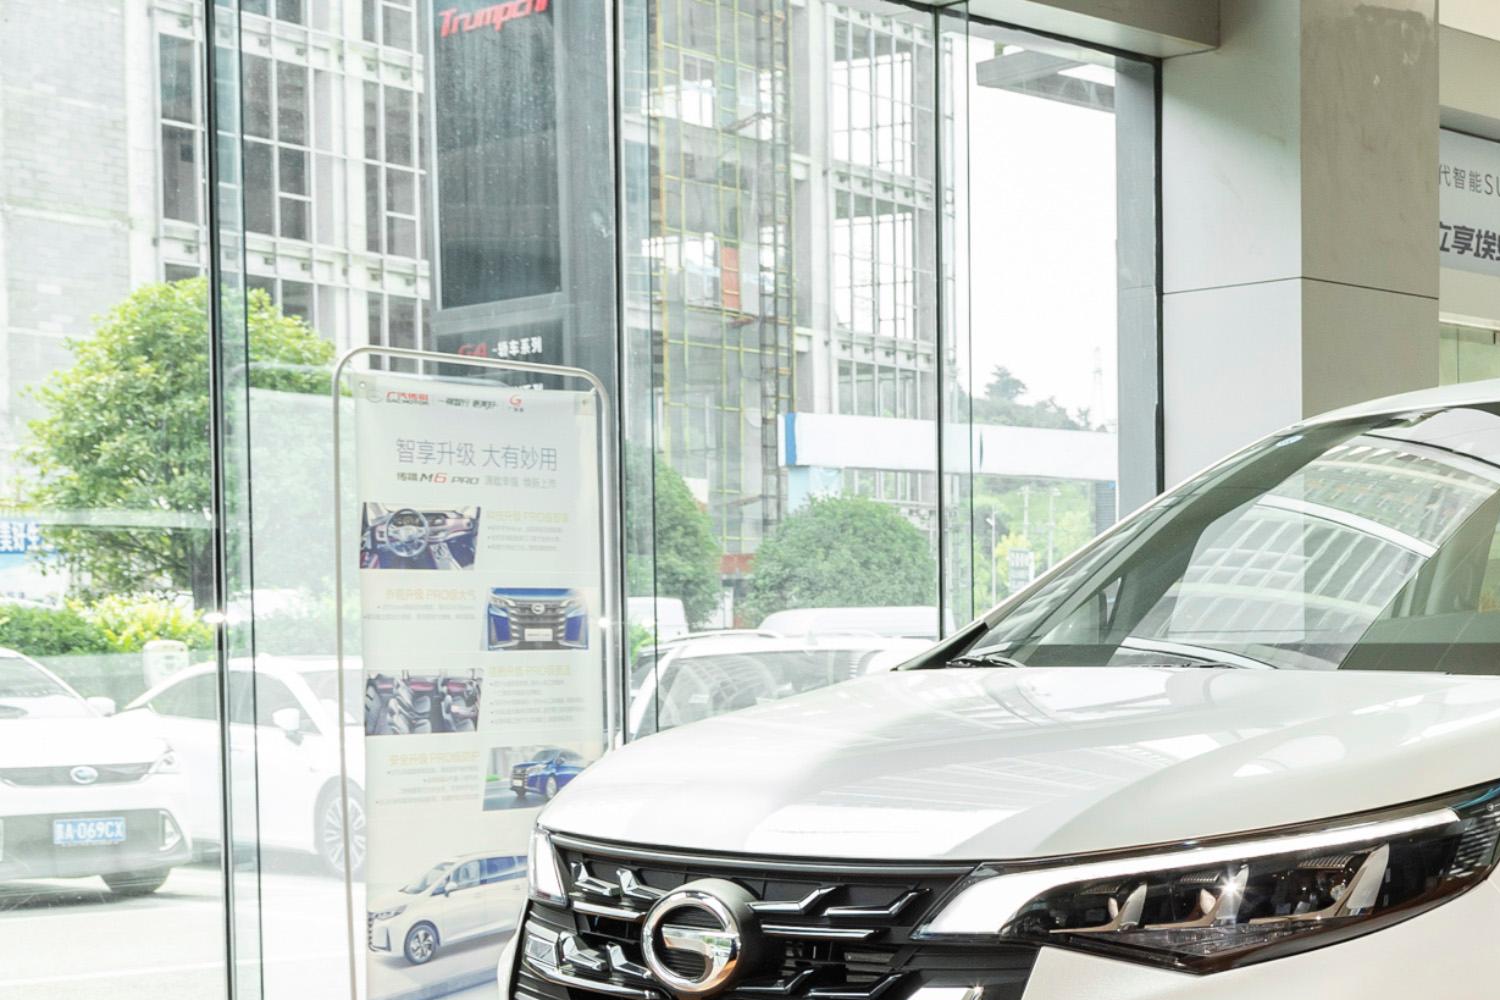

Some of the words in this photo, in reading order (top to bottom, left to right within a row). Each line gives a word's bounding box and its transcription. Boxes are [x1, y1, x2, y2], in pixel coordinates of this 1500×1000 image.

[396, 438, 477, 467] 智享升级
[481, 443, 558, 472] 大有妙用
